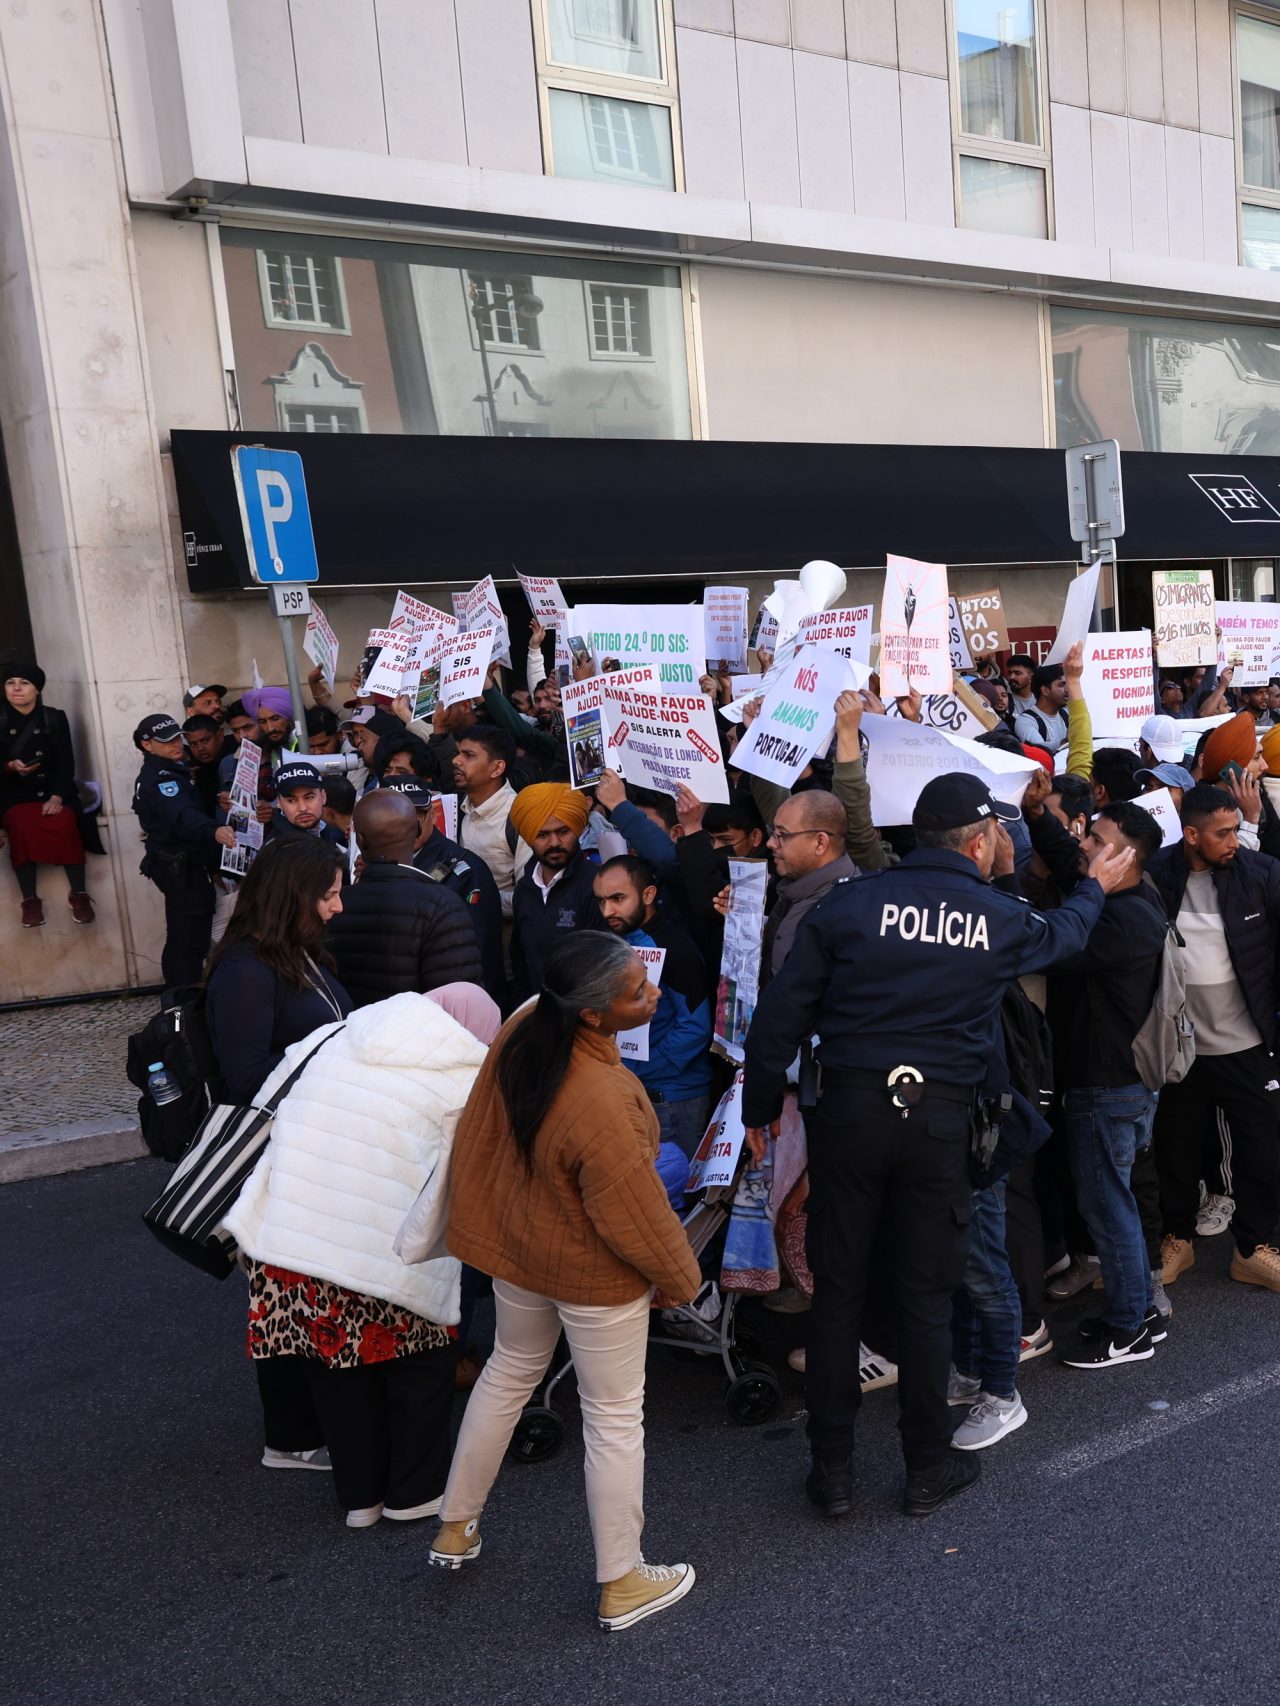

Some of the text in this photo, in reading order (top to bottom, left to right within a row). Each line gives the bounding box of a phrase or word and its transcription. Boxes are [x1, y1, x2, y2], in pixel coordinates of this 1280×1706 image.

[1208, 488, 1260, 508] HF
[256, 469, 293, 560] P
[283, 592, 303, 609] PSP
[399, 593, 456, 626] AIMA POR FAVOR
[540, 599, 555, 607] SIS
[800, 608, 868, 629] AIMA POR FAVOR
[1250, 618, 1279, 629] TEMOS
[377, 631, 397, 640] POR
[587, 631, 621, 651] ARTIGO
[650, 633, 665, 653] DO
[668, 634, 689, 653] SIS:
[805, 625, 856, 641] AJUDE-NOS
[424, 629, 492, 659] AIMA POR FAVOR
[431, 641, 477, 665] AJUDE-NOS
[925, 638, 939, 649] ESTE
[453, 656, 471, 668] SIS
[1092, 647, 1144, 661] ALERTAS
[443, 667, 480, 685] ALERTA
[659, 663, 693, 682] JUSTO
[793, 663, 819, 693] NÓS
[565, 684, 586, 701] AIMA
[610, 669, 653, 686] FAVOR
[604, 687, 706, 711] AIMA POR FAVOR
[620, 704, 689, 723] AJUDE-NOS
[771, 700, 819, 732] AMAMOS
[630, 723, 682, 739] SIS ALERTA
[664, 748, 674, 759] DE
[675, 749, 703, 762] LONGO
[687, 730, 718, 762] JUSTIÇA
[277, 768, 314, 783] POLÍCIA
[660, 764, 691, 779] MERECE
[880, 901, 990, 951] POLÍCIA
[620, 1041, 639, 1053] JUSTIÇA
